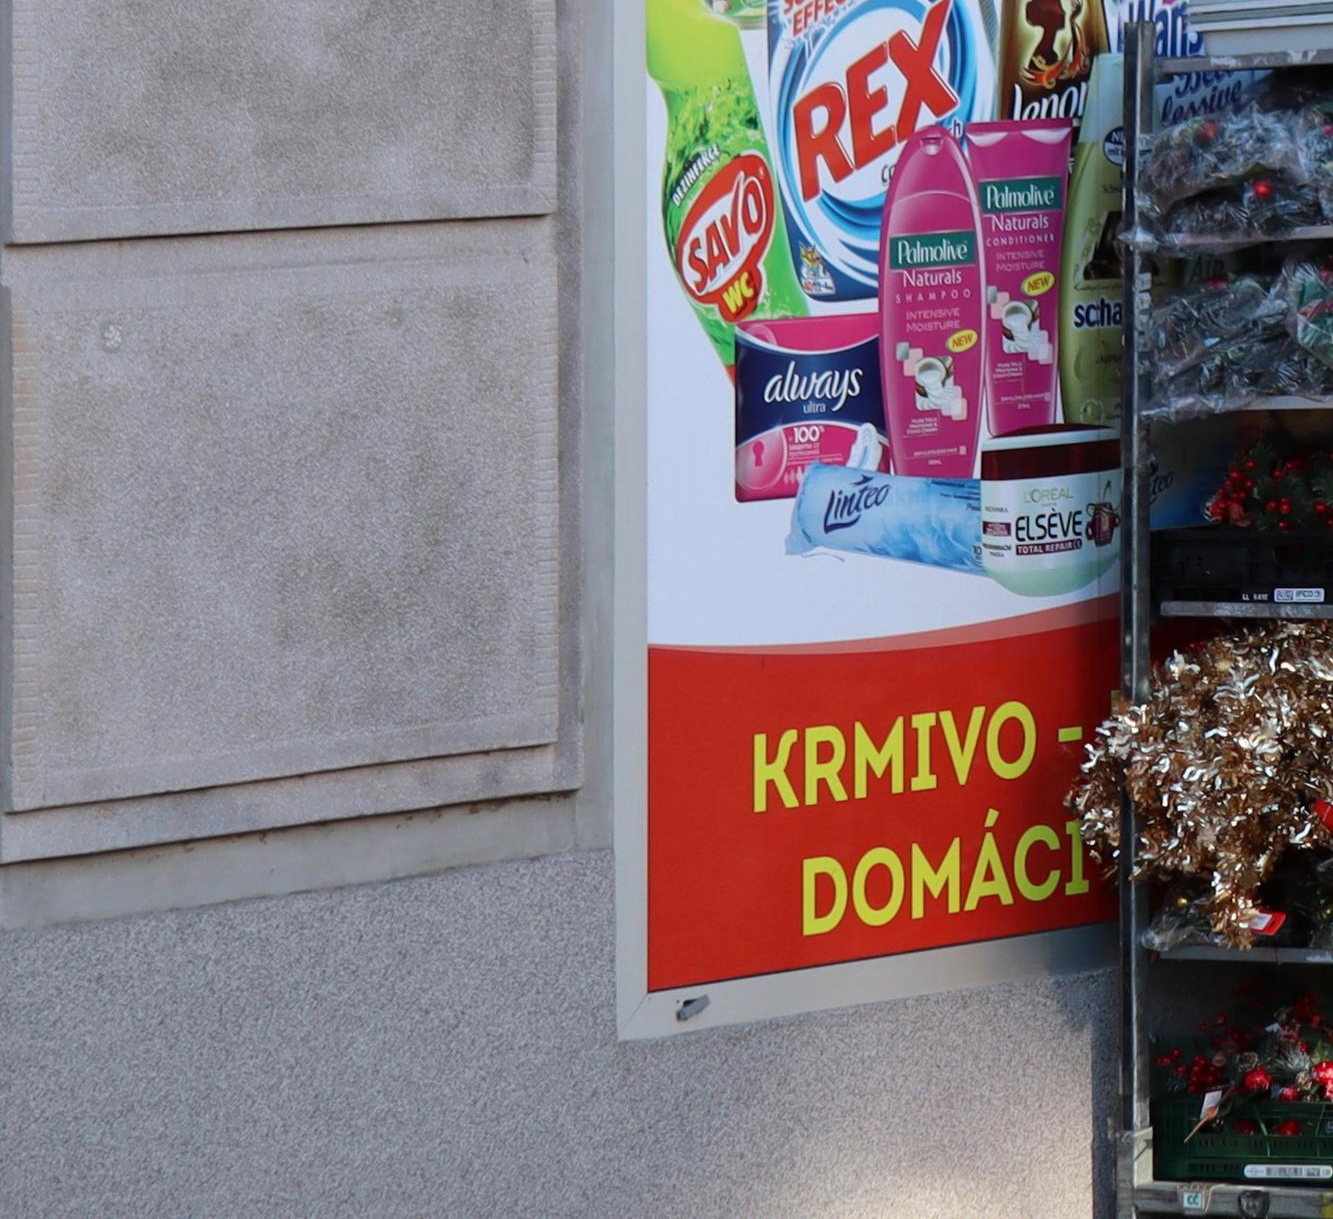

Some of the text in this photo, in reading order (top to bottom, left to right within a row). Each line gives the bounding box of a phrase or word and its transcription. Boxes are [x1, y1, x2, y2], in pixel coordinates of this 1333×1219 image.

[672, 142, 721, 206] DEZINFEKCE
[986, 178, 1055, 210] Palmolive
[991, 213, 1049, 232] Naturals
[688, 171, 766, 294] SAVO
[985, 234, 1056, 247] CONDITIONER
[898, 236, 968, 265] Palmolive
[995, 249, 1046, 261] INTENSIVE
[995, 261, 1046, 273] MOISTURE
[902, 269, 963, 288] Naturals
[1027, 276, 1050, 291] NEW
[722, 271, 755, 314] WC
[895, 289, 972, 304] SHAMPOO
[905, 308, 961, 320] INTENSIVE
[905, 320, 961, 332] MOISTURE
[951, 332, 974, 348] NEW
[764, 360, 863, 412] always
[803, 401, 826, 414] ultra
[824, 473, 892, 535] Linteo
[1015, 507, 1083, 543] ELSÈVE
[1017, 543, 1044, 555] TOTAL
[1045, 541, 1073, 554] REPAIR
[754, 700, 1036, 813] KRMIVO
